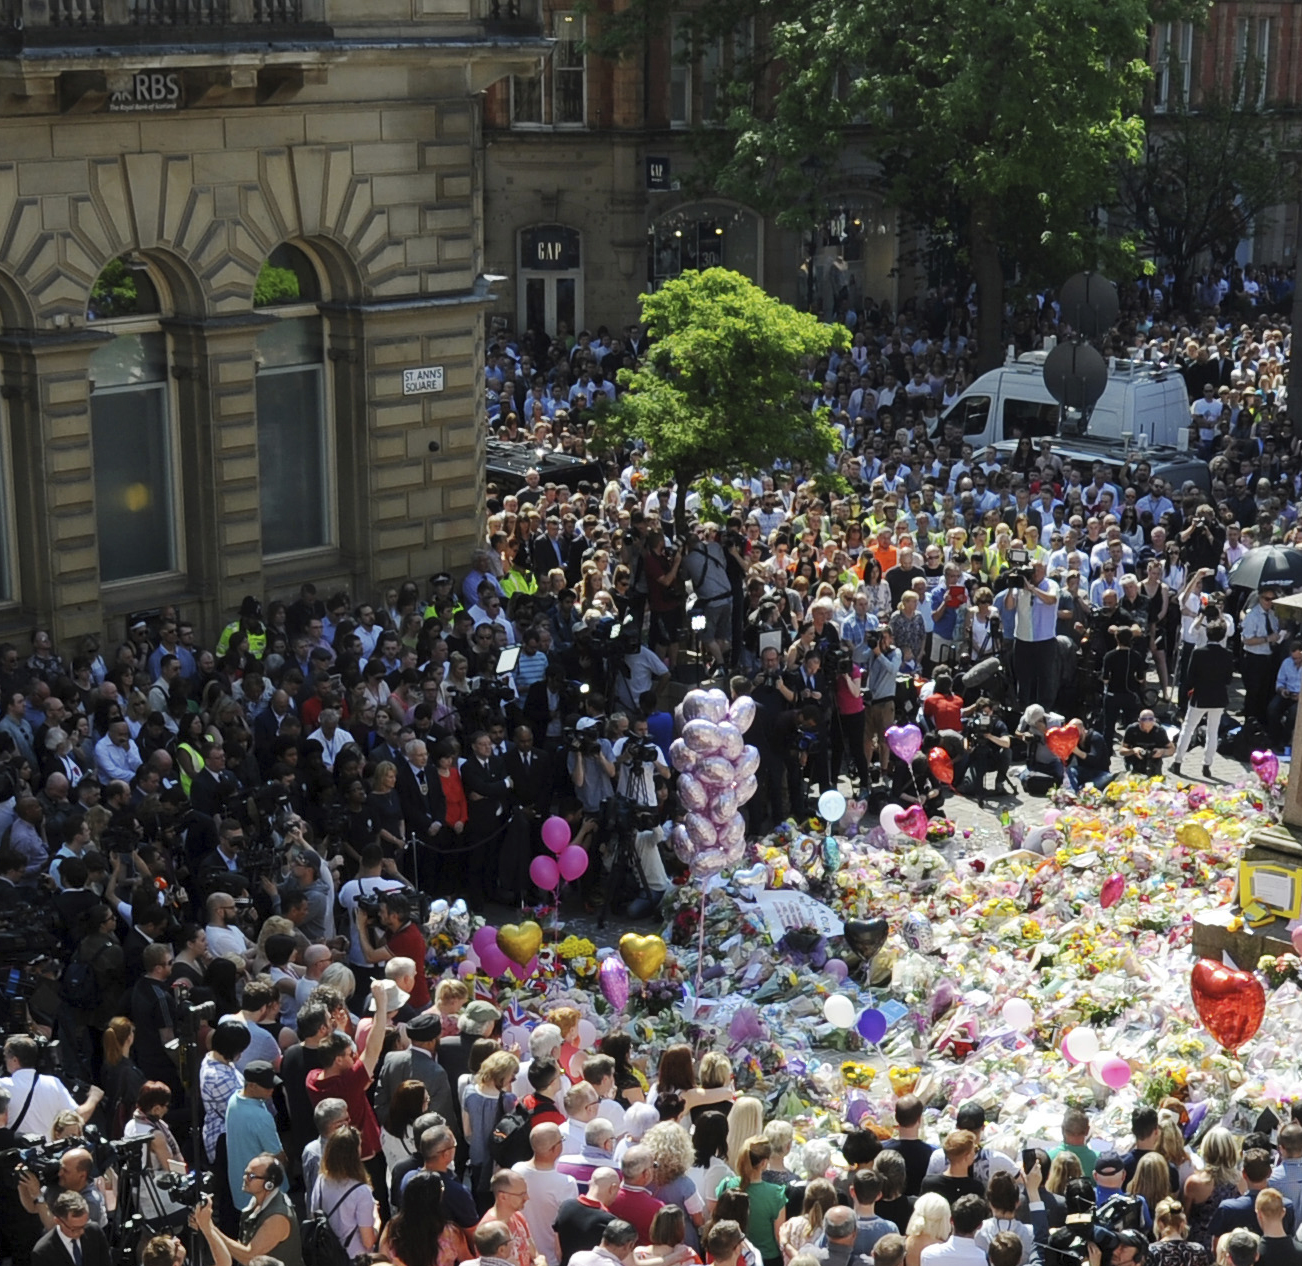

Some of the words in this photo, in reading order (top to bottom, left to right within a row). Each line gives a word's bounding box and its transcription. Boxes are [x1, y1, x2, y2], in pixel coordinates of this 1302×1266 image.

[135, 74, 178, 101] RBS
[537, 242, 562, 260] GAP
[405, 380, 437, 392] SQUARE
